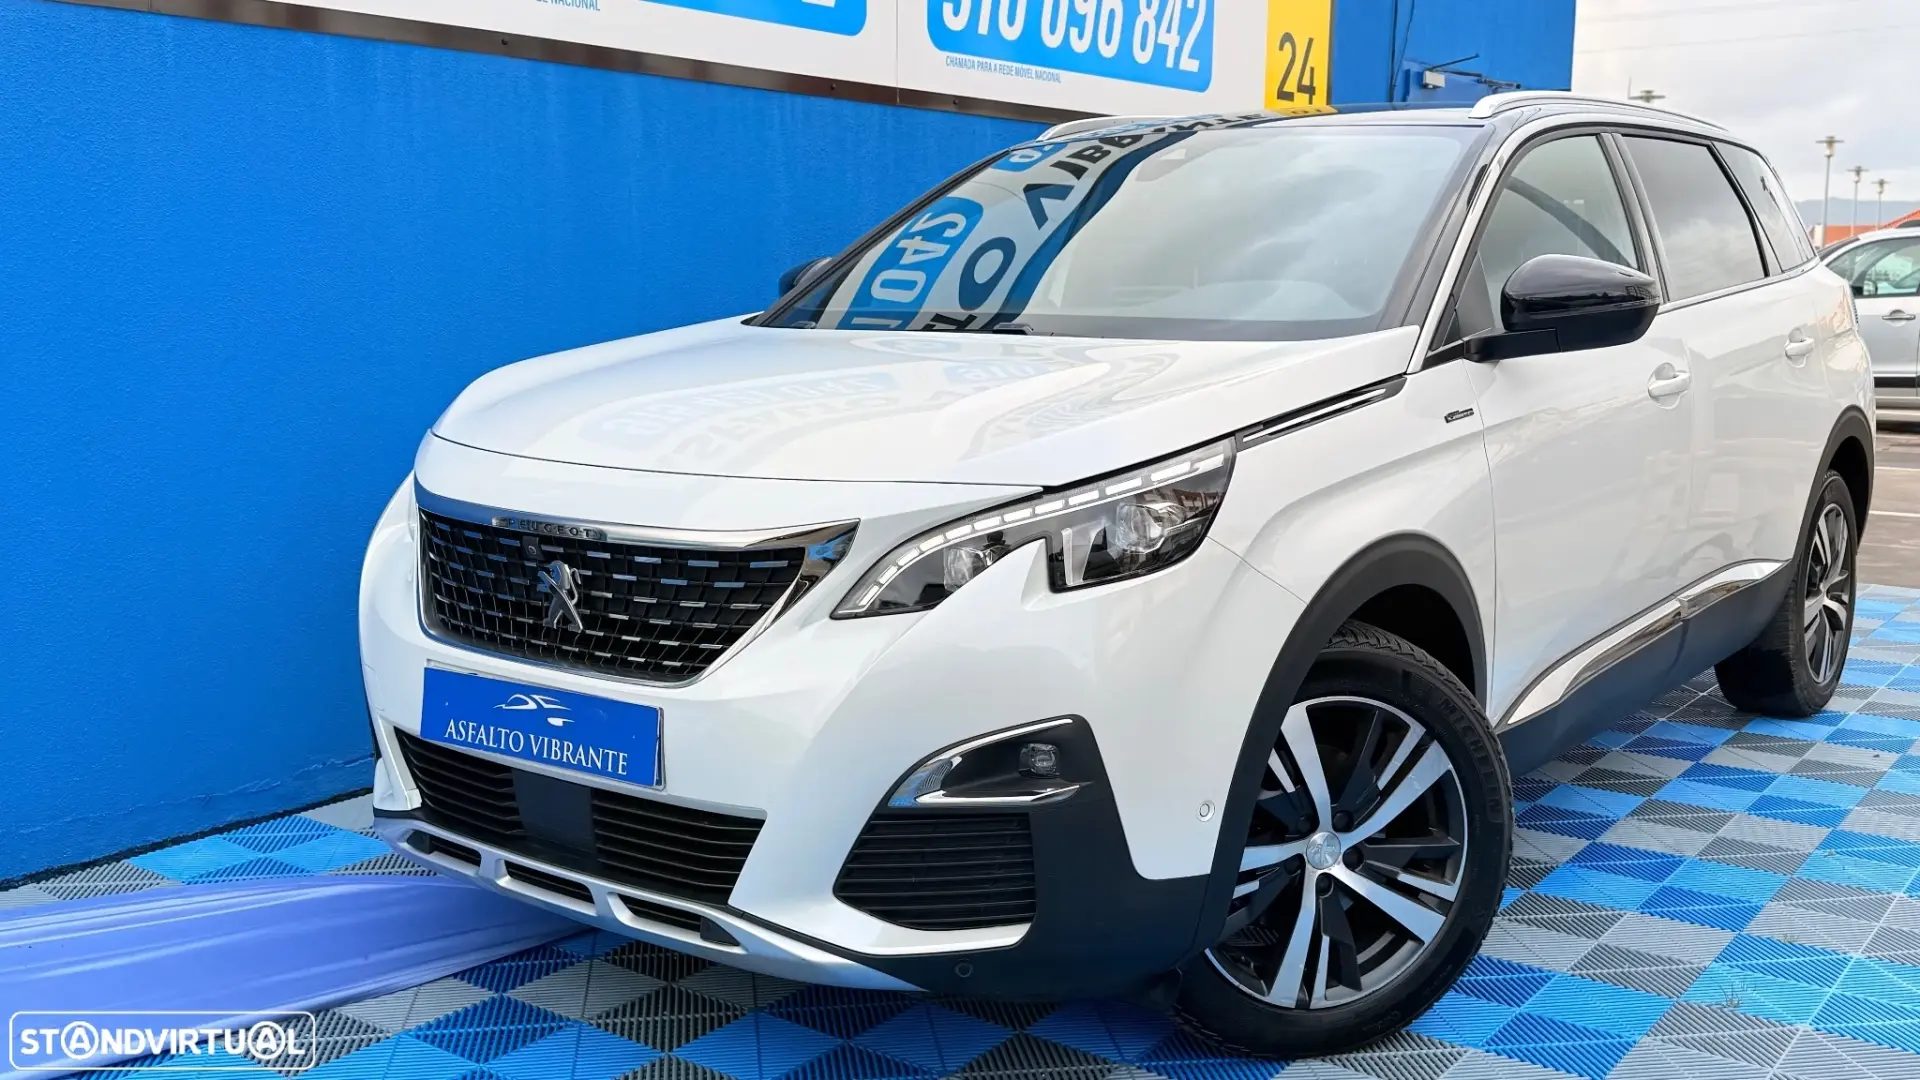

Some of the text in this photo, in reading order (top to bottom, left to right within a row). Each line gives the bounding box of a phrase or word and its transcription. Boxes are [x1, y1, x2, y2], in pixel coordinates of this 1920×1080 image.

[1133, 0, 1206, 72] 842
[945, 55, 976, 70] CHAMADA
[977, 60, 992, 73] PARA
[999, 64, 1014, 76] REDE
[1015, 65, 1034, 79] MÓVEL
[1035, 70, 1061, 83] NACIONAL
[1277, 31, 1316, 105] 24
[508, 520, 594, 538] PEUGEOT
[444, 718, 628, 775] ASFALTO VIBRANTE
